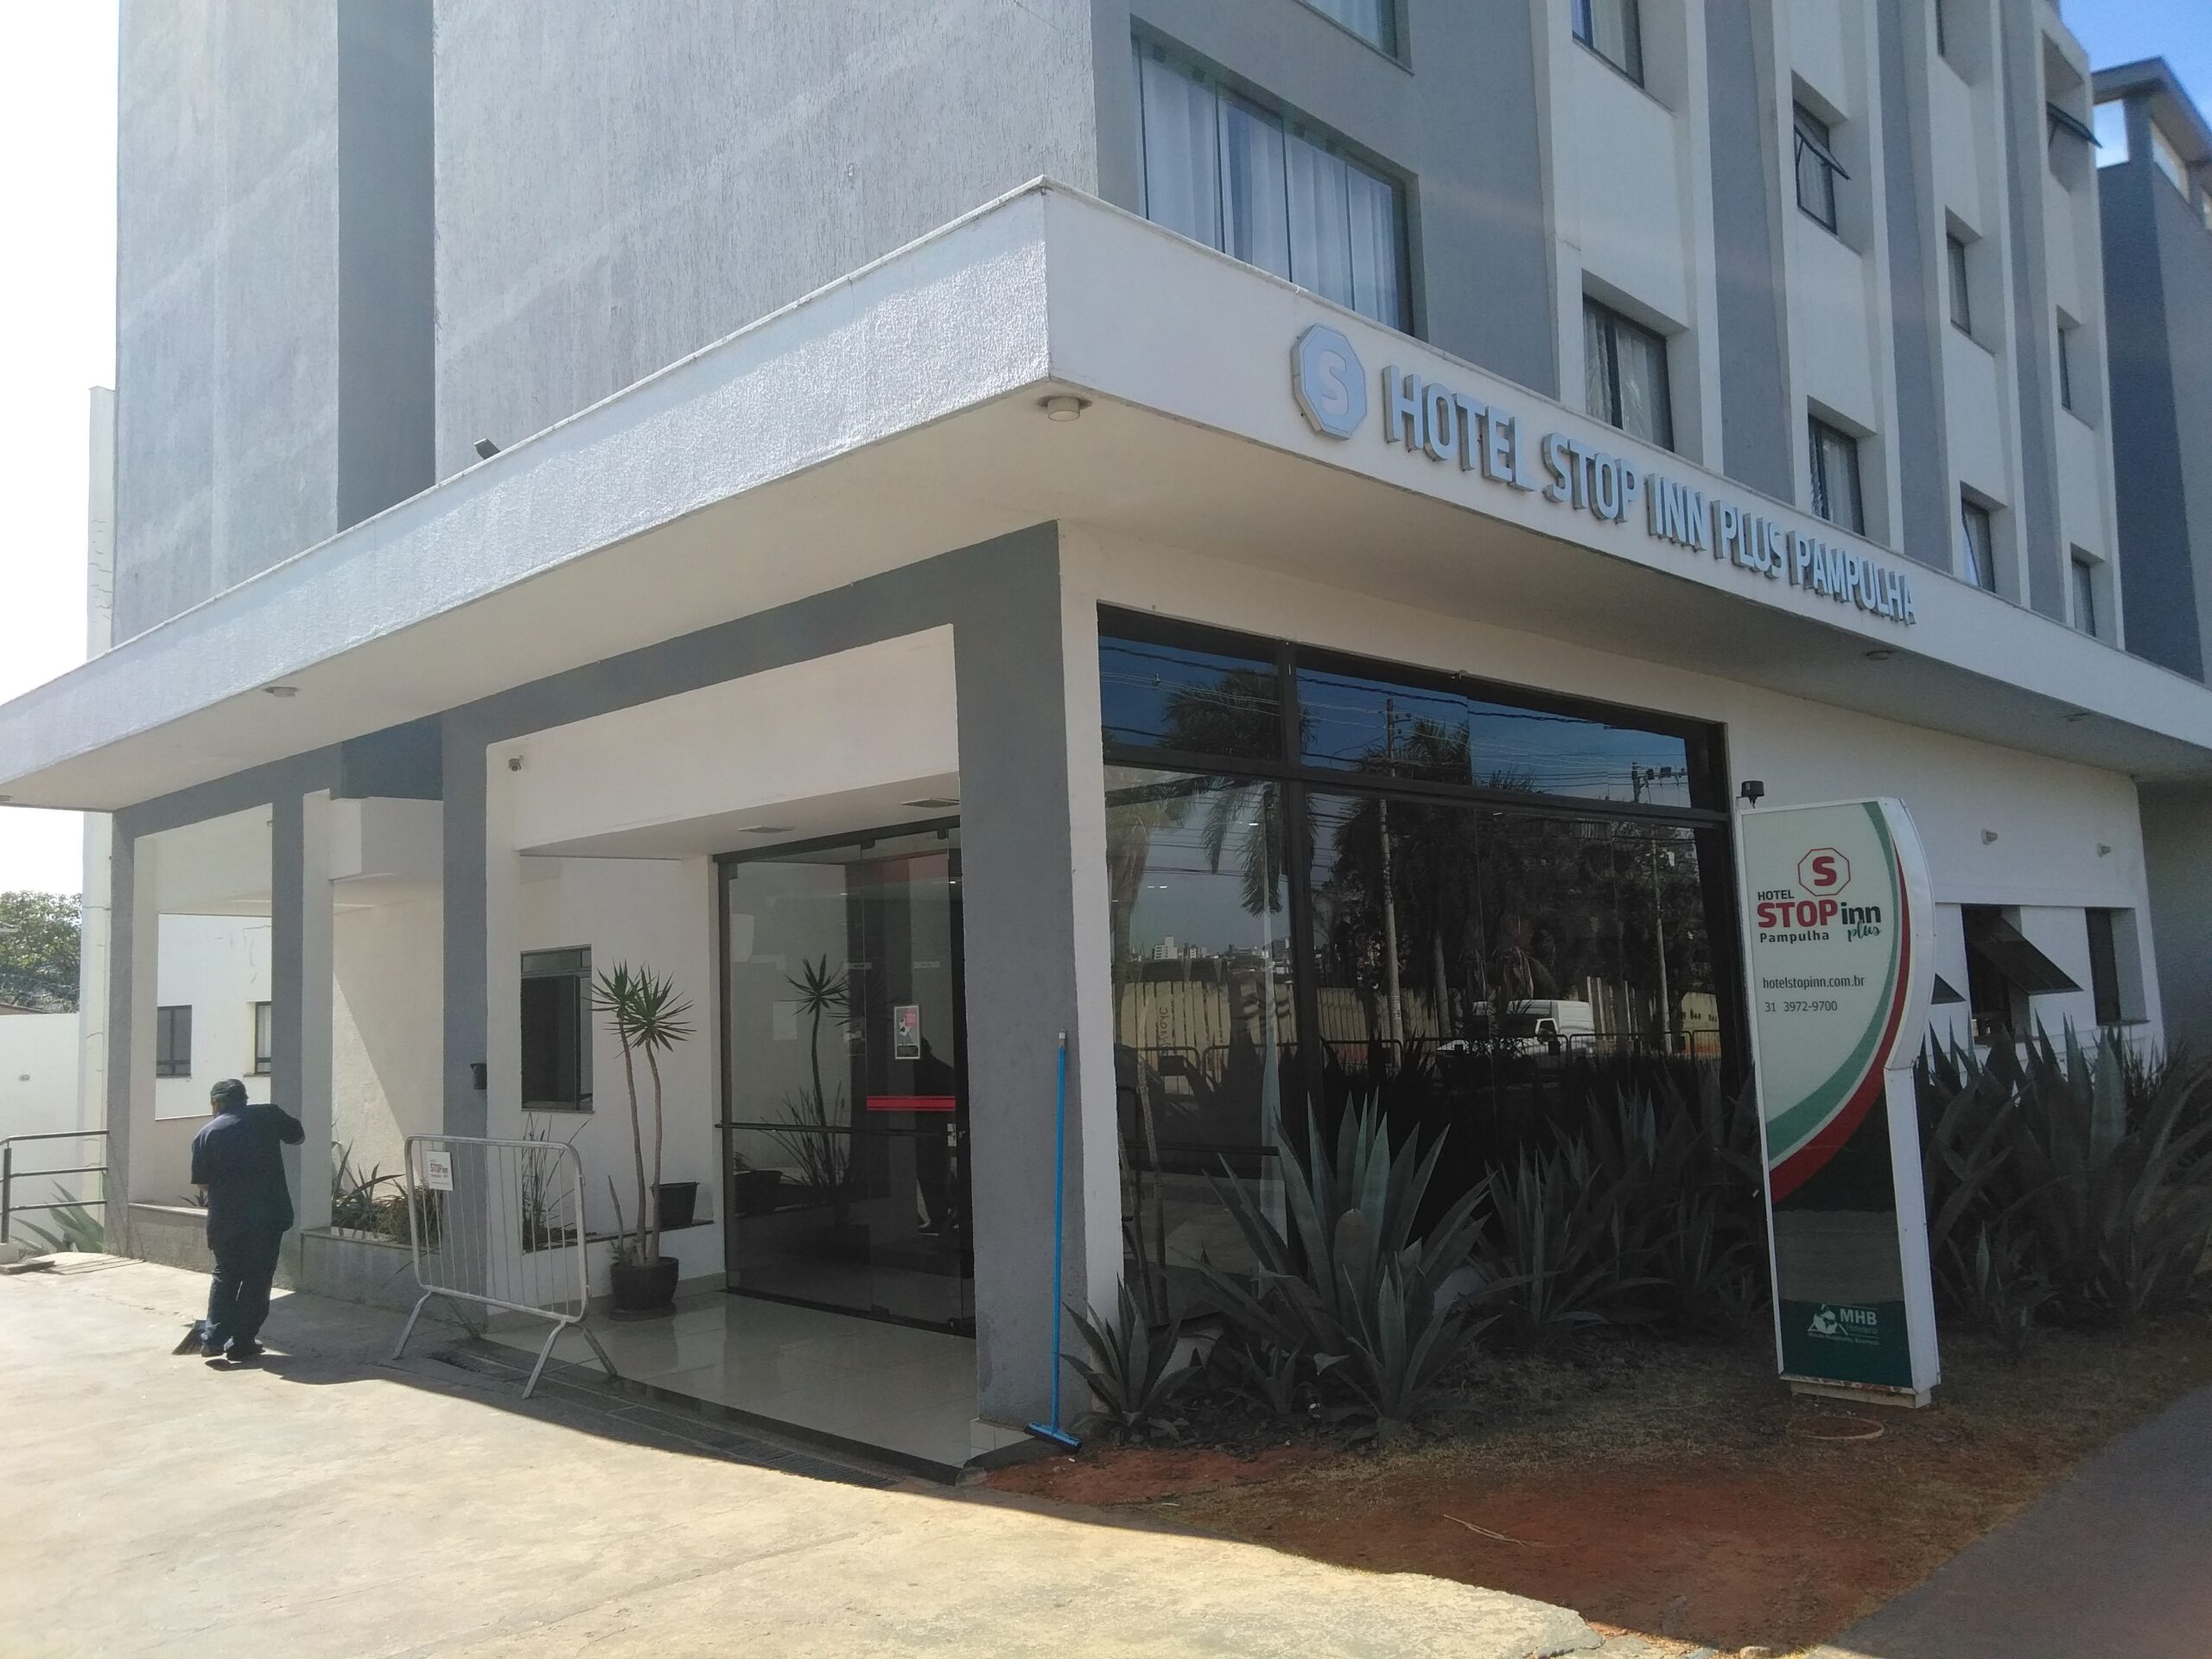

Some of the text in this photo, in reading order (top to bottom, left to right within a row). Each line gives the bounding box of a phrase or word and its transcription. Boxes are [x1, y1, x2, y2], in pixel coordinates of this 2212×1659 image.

[1382, 364, 1535, 492] HOTEL
[1542, 433, 1637, 524] STOP
[1645, 473, 1707, 552] INN
[1710, 499, 1784, 580] PLUS
[1788, 530, 1916, 625] PAMPULHA
[1812, 855, 1837, 887] S
[1758, 889, 1795, 900] HOTEL
[1759, 931, 1830, 944] Pampulha
[1847, 919, 1882, 942] plus
[1763, 975, 1866, 989] hotelstopinn.com.br
[1764, 1001, 1838, 1012] 31 3972-9700
[1840, 1308, 1877, 1325] MHB
